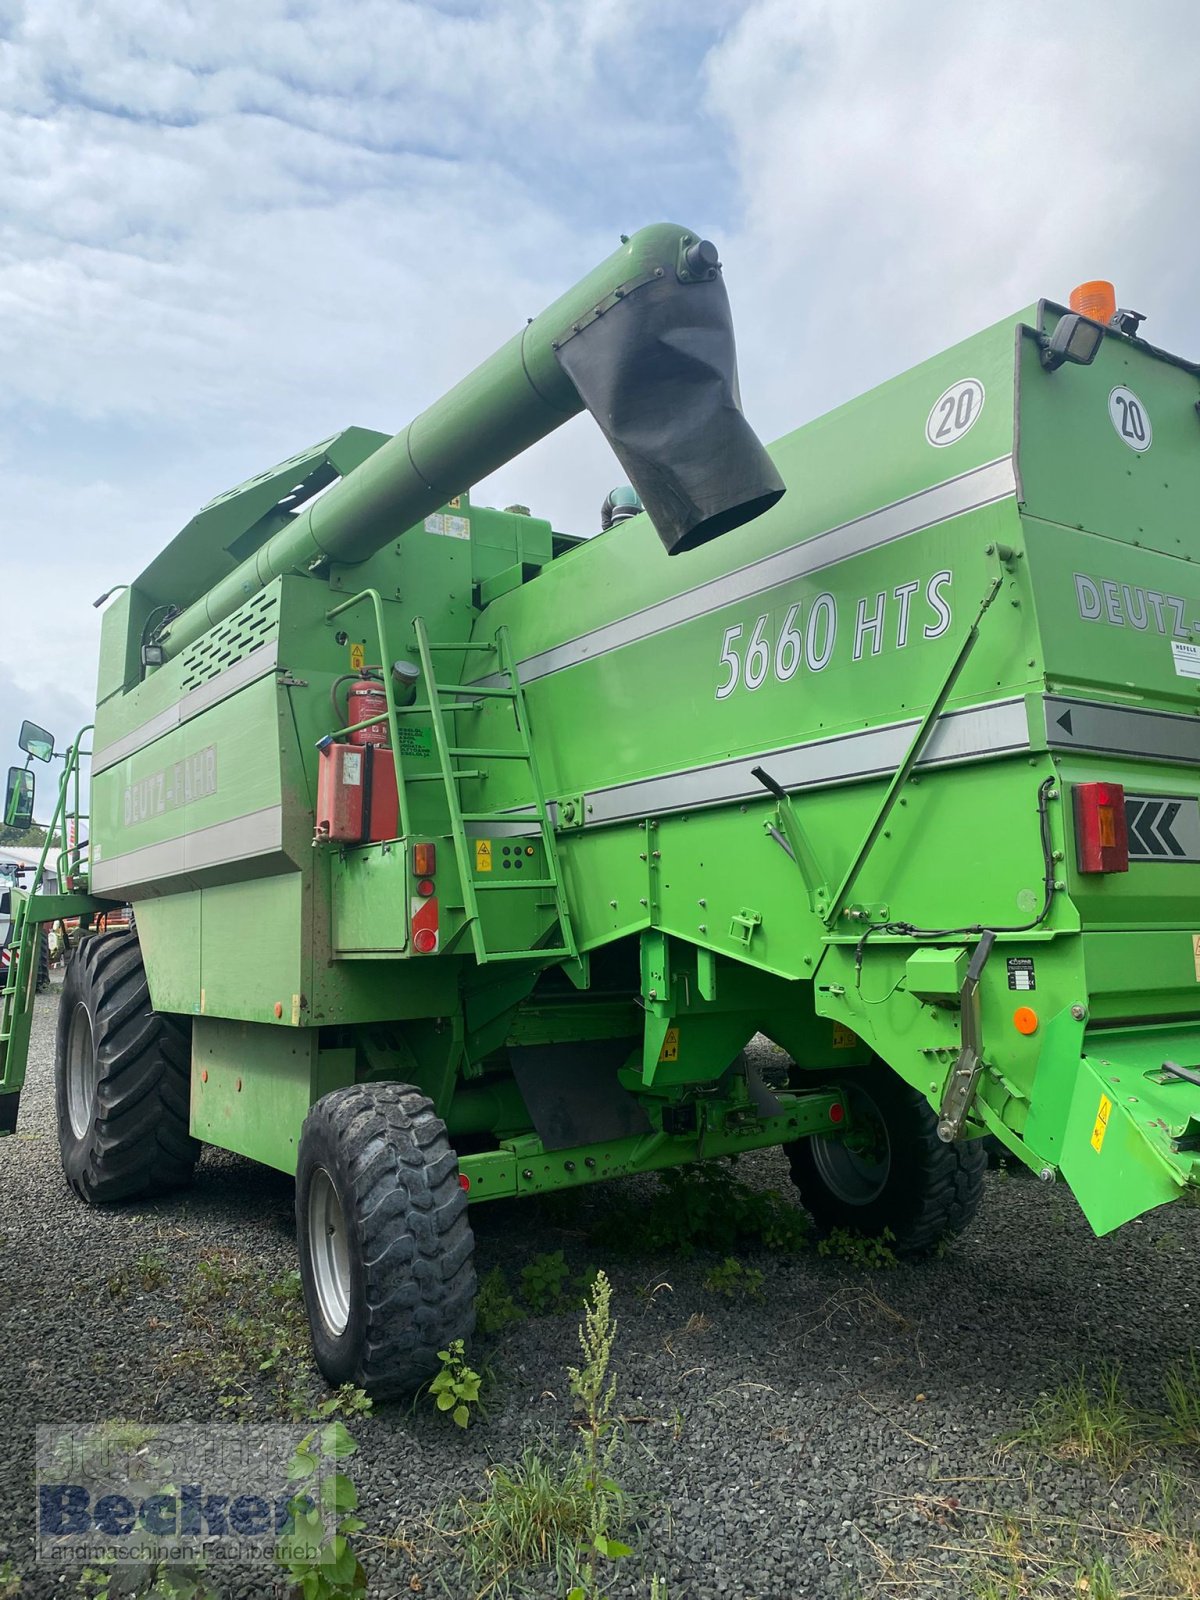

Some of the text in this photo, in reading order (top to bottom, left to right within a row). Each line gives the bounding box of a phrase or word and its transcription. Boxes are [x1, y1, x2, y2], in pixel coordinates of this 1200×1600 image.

[935, 388, 974, 439] 20
[1116, 396, 1145, 441] 20
[715, 570, 952, 700] 5660 HTS
[124, 746, 216, 828] DEUTZ-FAHR
